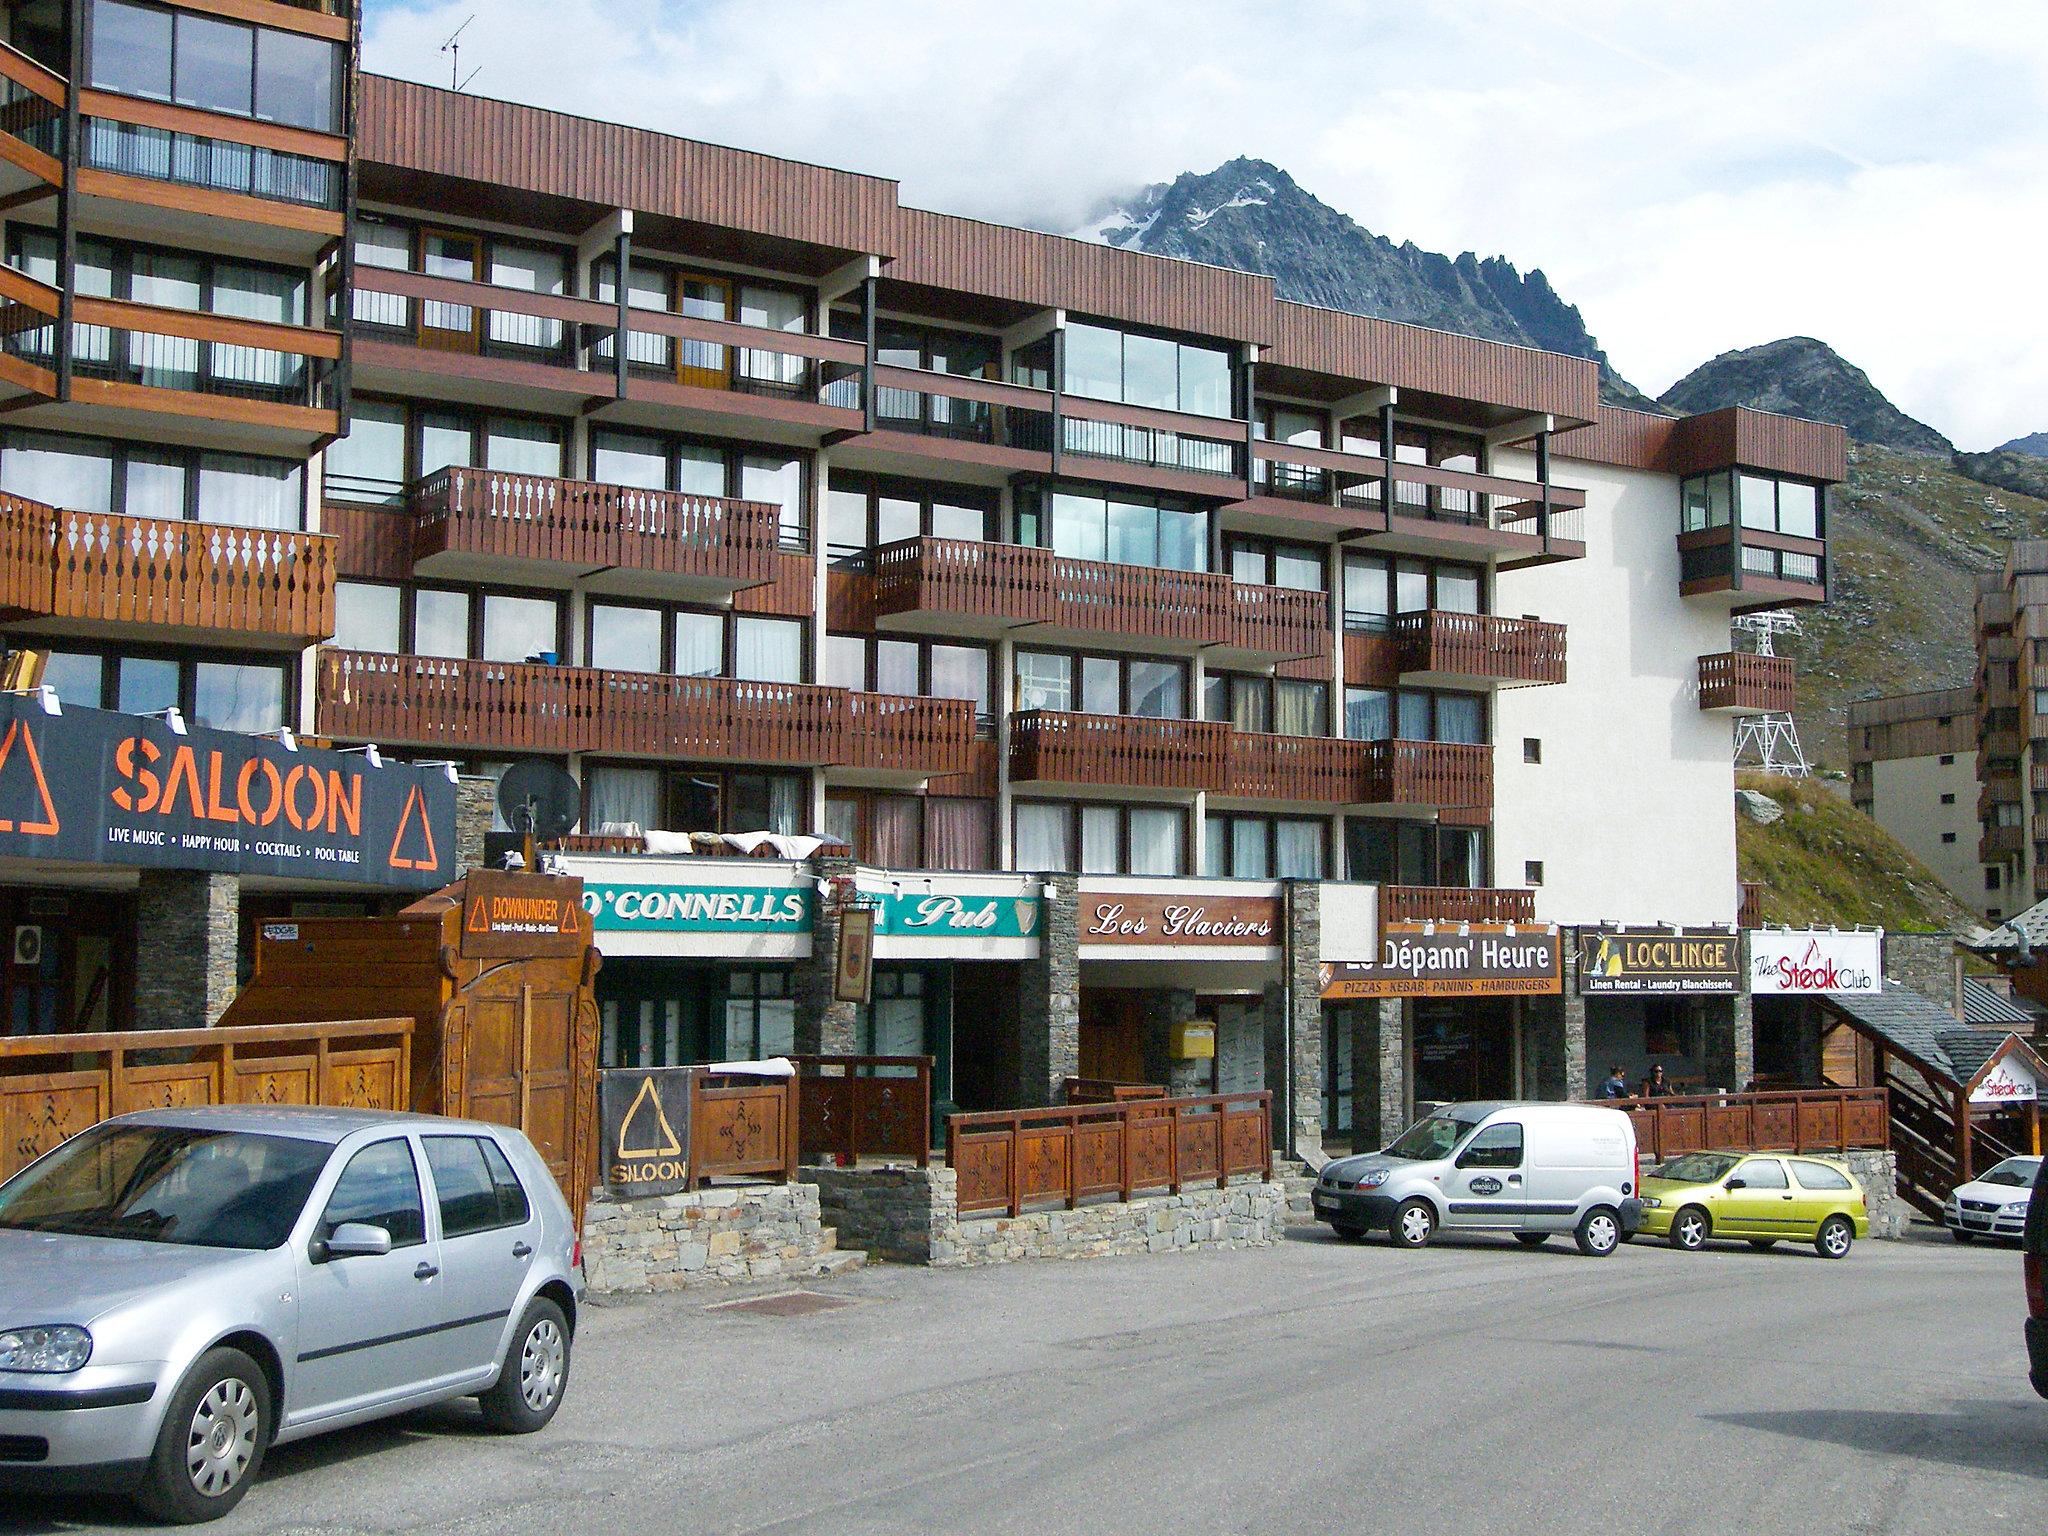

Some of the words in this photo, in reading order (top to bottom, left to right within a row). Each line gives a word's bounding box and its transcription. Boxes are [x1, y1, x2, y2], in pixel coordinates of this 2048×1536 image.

[111, 737, 362, 836] SALOON
[108, 827, 130, 843] LIVE
[132, 829, 165, 846] MUSIC
[182, 835, 212, 850] HAPPY
[214, 837, 240, 852] HOUR
[255, 842, 301, 857] COCKTAILS
[315, 847, 337, 861] POOL
[337, 850, 360, 863] TABLE
[493, 897, 558, 920] DOWNUNDER
[582, 890, 805, 922] O'CONNELLS
[904, 895, 998, 928] Pub
[1088, 903, 1148, 935] Les
[1162, 905, 1272, 936] Glaciers
[1482, 940, 1548, 969] Heure
[1627, 942, 1726, 968] LOC'LINGE
[1344, 983, 1381, 993] PIZZAS
[1390, 982, 1424, 992] KEBAB
[1433, 981, 1473, 992] PANINIS
[1481, 979, 1550, 991] HAMBURGERS
[1590, 979, 1612, 989] Linen
[1615, 980, 1640, 989] Rental
[1648, 980, 1680, 991] Laundry
[1682, 979, 1733, 990] Blanchisserie
[1755, 956, 1778, 976] The
[1778, 956, 1839, 989] Steak
[1840, 969, 1871, 989] Club
[1986, 1079, 2017, 1096] Steak
